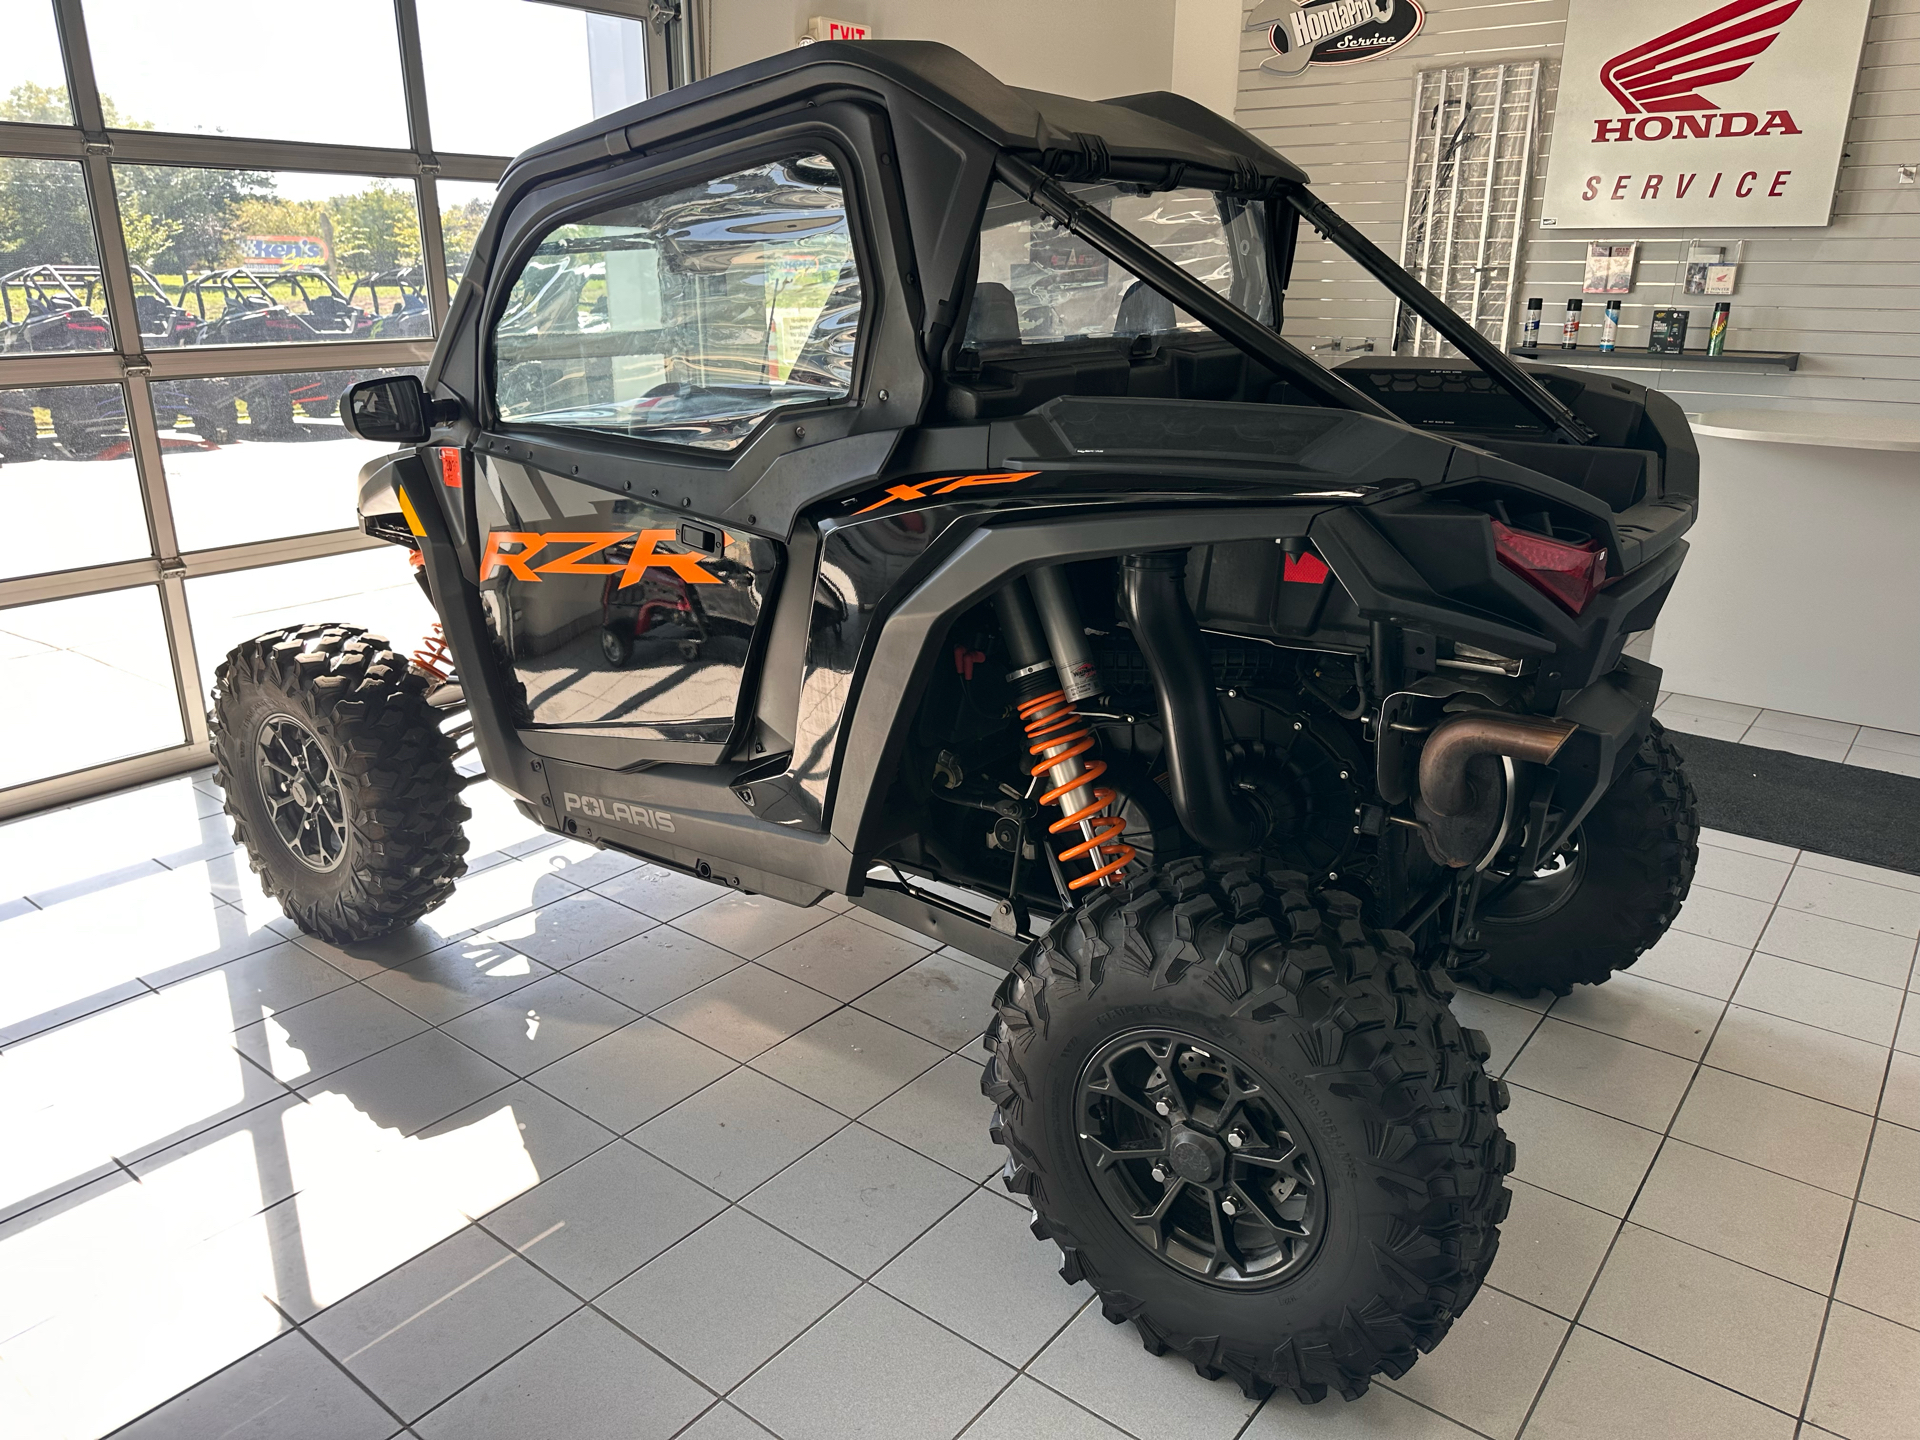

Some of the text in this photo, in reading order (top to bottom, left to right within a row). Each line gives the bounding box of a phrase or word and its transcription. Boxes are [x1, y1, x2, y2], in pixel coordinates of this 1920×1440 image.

[1289, 0, 1373, 47] HondaPro
[1336, 32, 1397, 49] Service
[1591, 110, 1803, 143] HONDA
[1582, 170, 1792, 201] SERVICE
[255, 239, 320, 258] ken's
[850, 471, 1043, 517] XP
[479, 529, 736, 590] RZR
[563, 792, 676, 834] POLARIS
